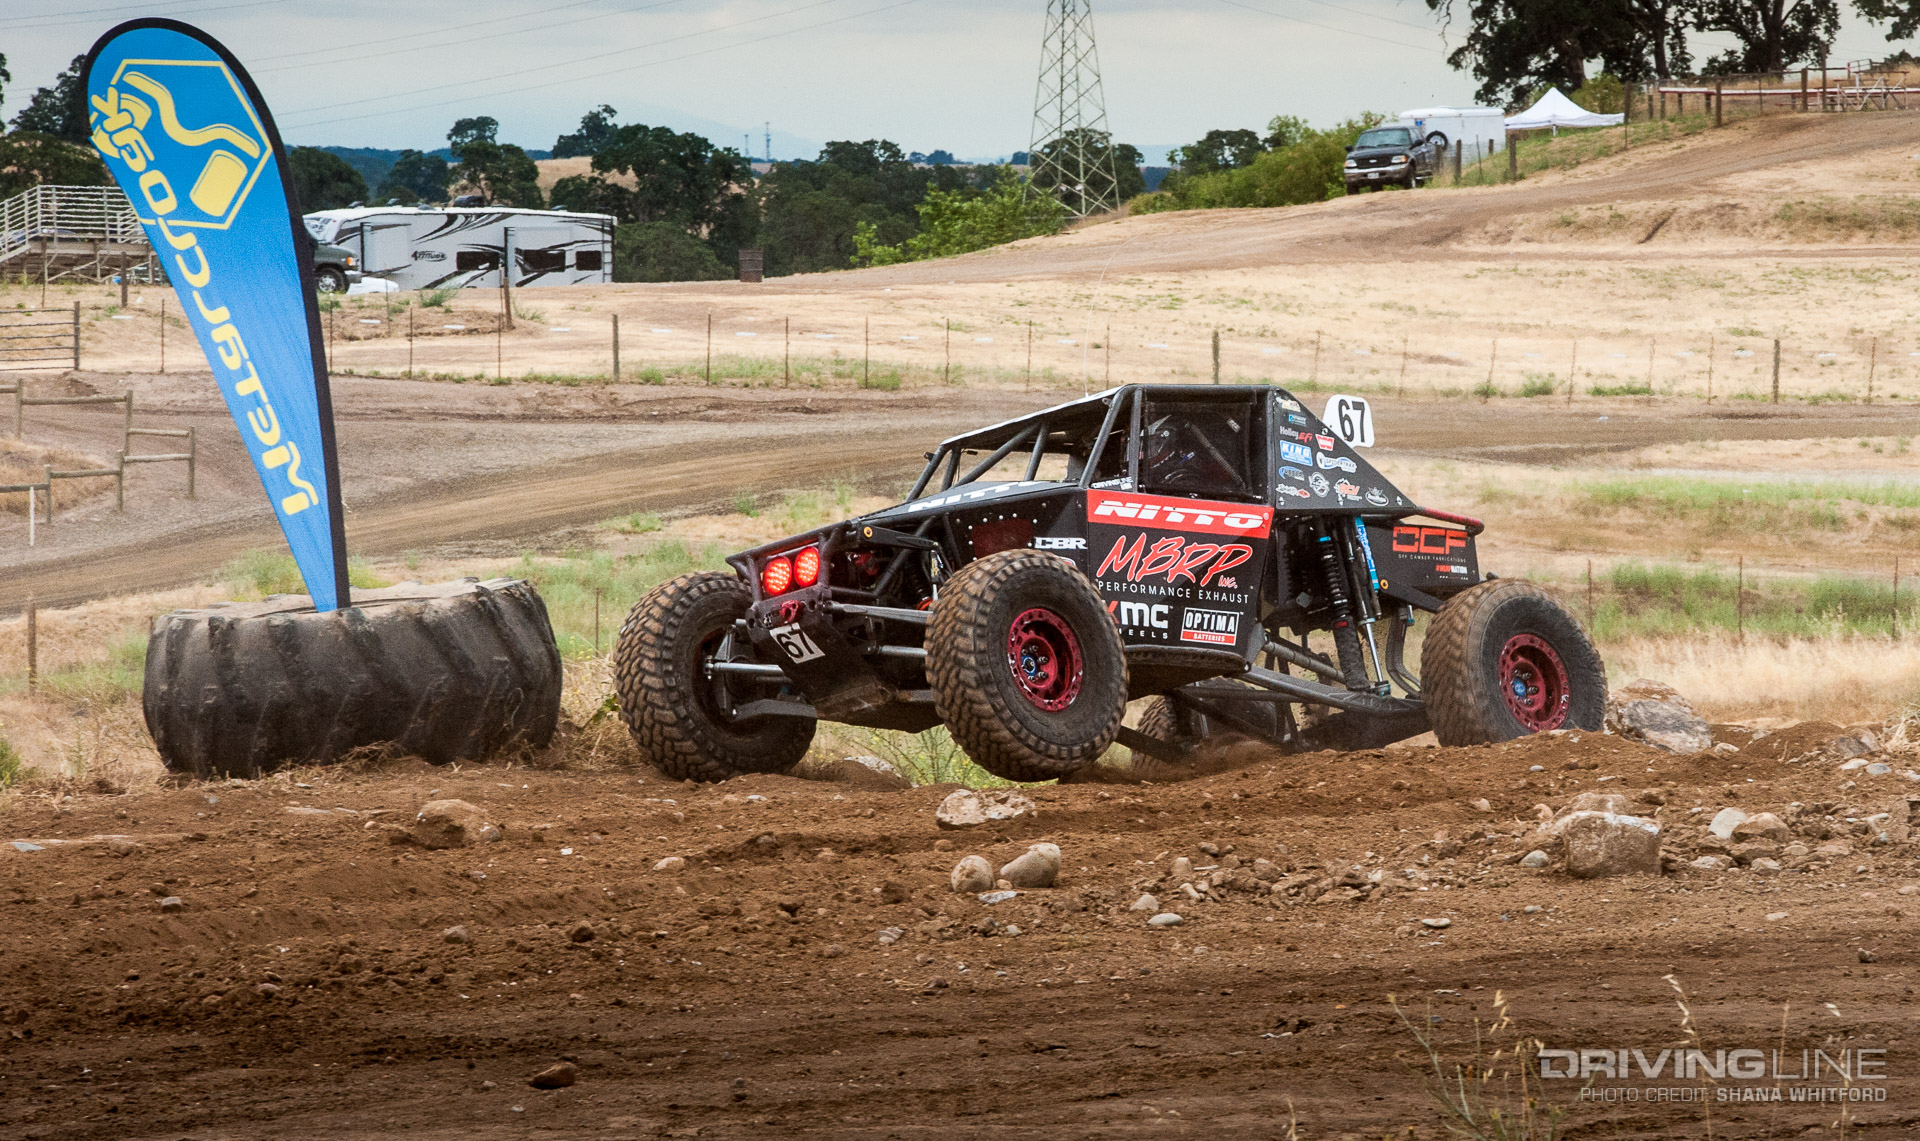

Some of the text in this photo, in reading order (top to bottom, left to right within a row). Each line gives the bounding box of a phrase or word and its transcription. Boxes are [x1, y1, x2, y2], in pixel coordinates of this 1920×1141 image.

[1279, 426, 1299, 440] Holley
[1338, 399, 1366, 443] 67
[1034, 536, 1088, 550] CBR
[1392, 526, 1468, 555] OCF
[1096, 532, 1254, 587] MBRP
[1098, 580, 1249, 604] PERFORMANCE EXHAUST
[1185, 609, 1236, 634] OPTIMA
[776, 628, 815, 659] 67
[1193, 632, 1226, 643] BATTERIES
